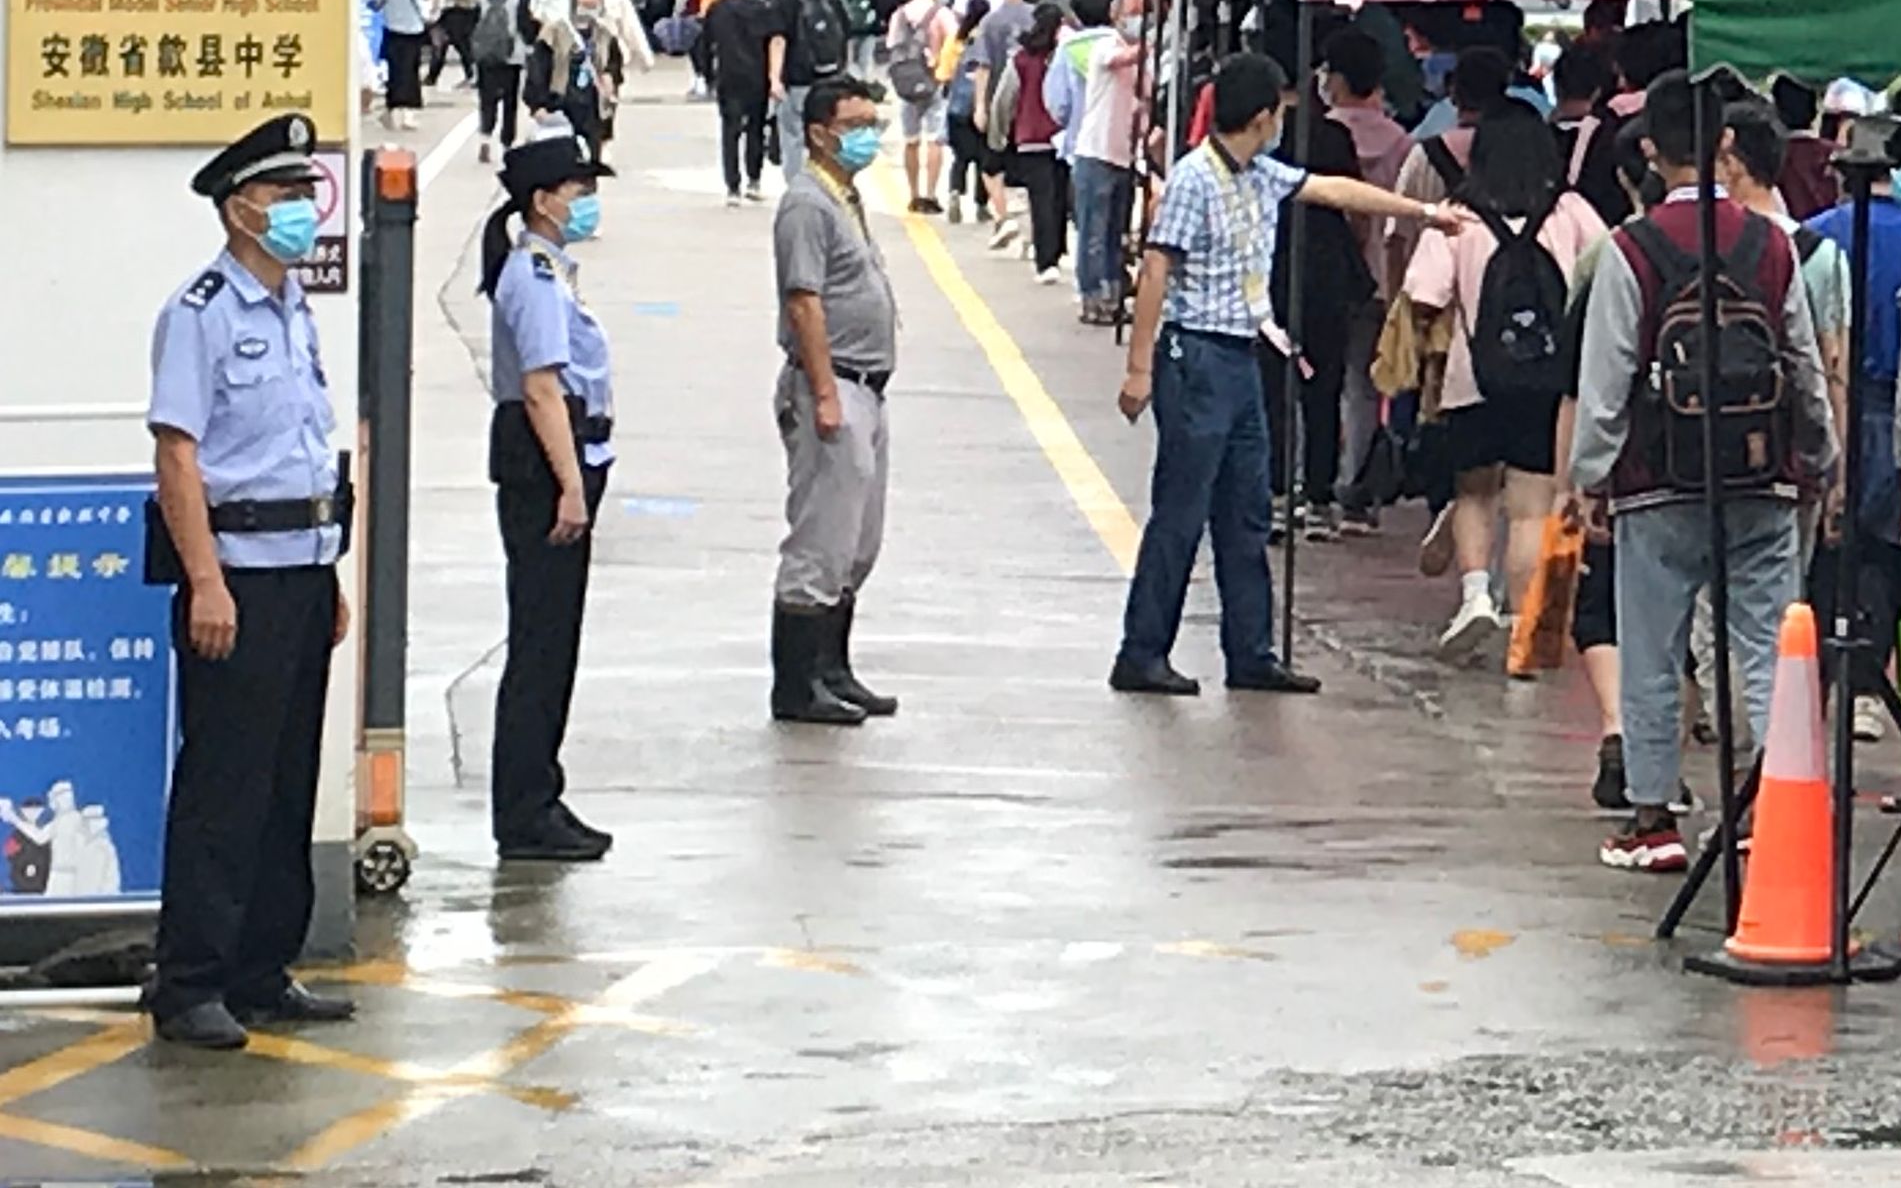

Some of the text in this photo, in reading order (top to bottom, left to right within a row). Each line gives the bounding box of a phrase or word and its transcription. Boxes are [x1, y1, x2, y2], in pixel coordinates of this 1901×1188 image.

[41, 32, 304, 79] 安徽省歙县中学
[31, 90, 313, 113] Shexian High School of Anhui
